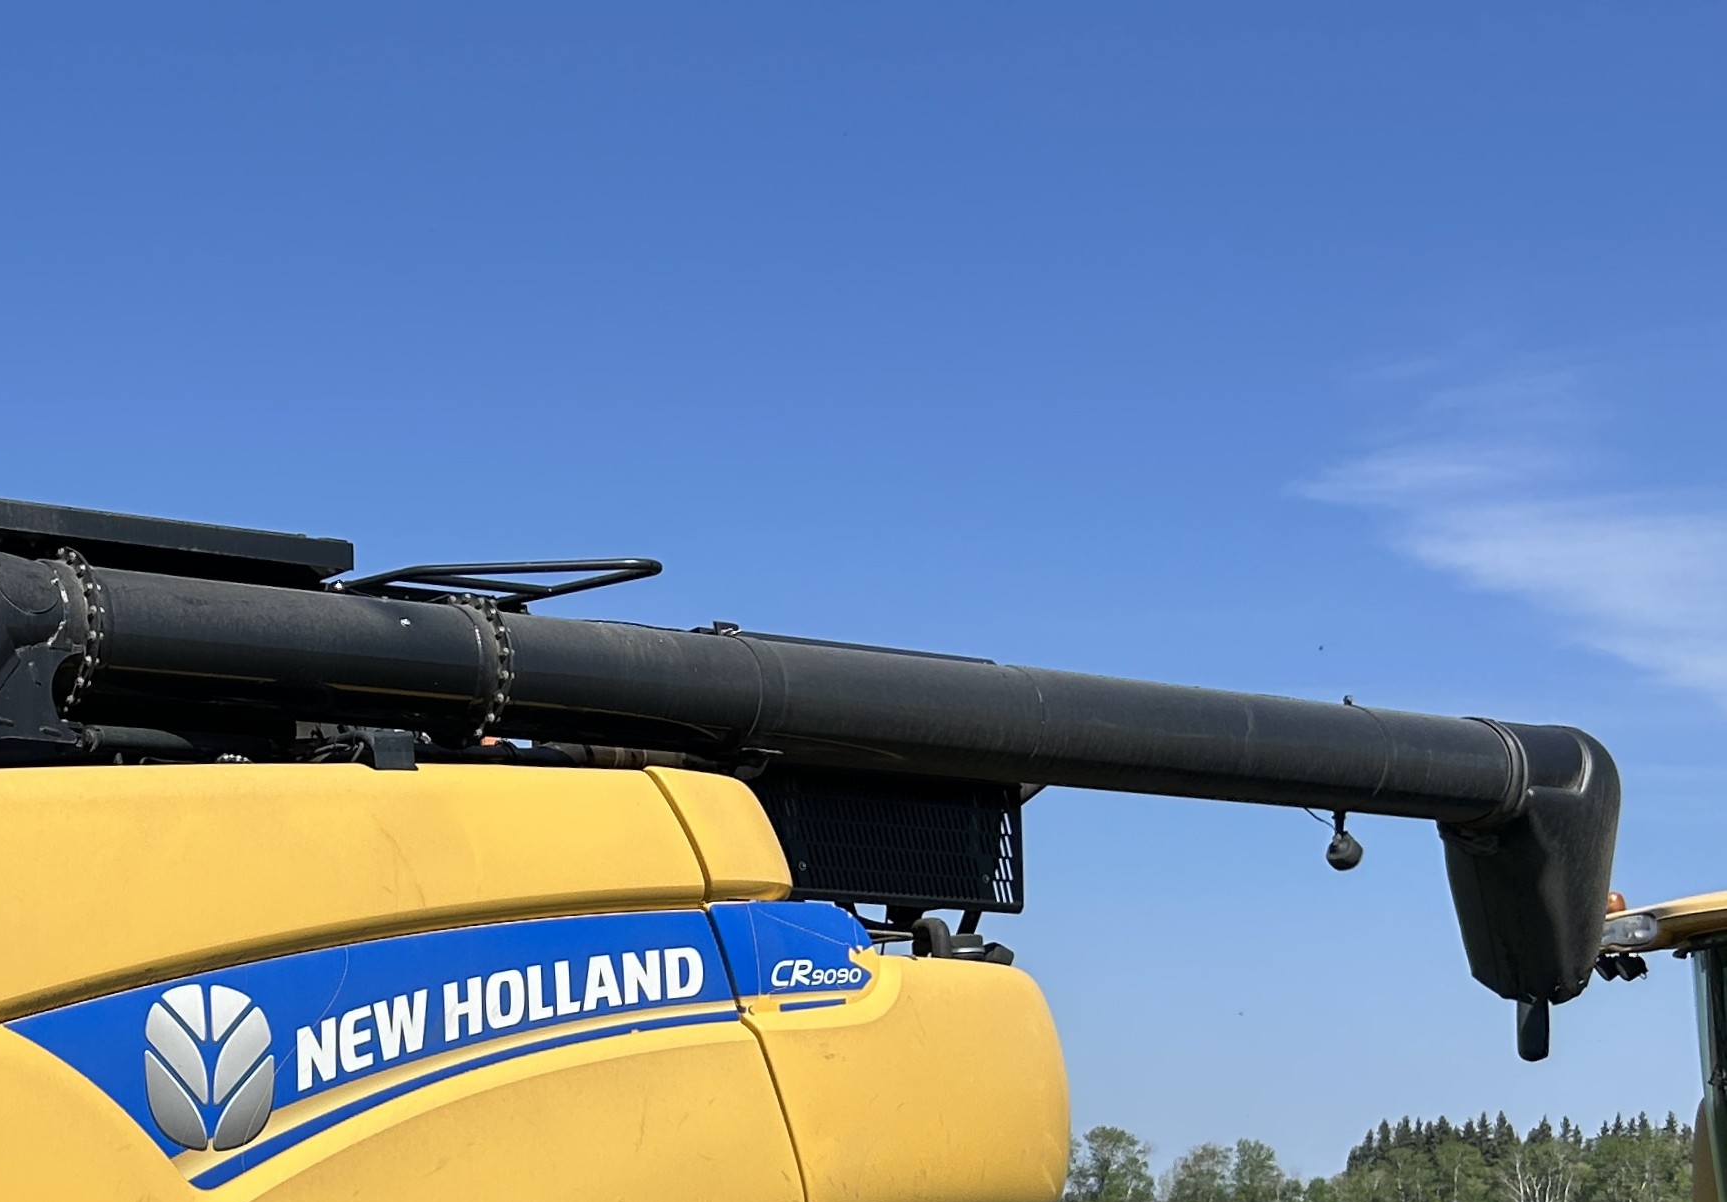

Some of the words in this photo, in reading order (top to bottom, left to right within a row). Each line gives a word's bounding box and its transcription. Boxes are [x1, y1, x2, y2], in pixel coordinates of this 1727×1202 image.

[770, 959, 862, 987] CR9090
[296, 988, 428, 1093] NEW
[442, 946, 704, 1043] HOLLAND
